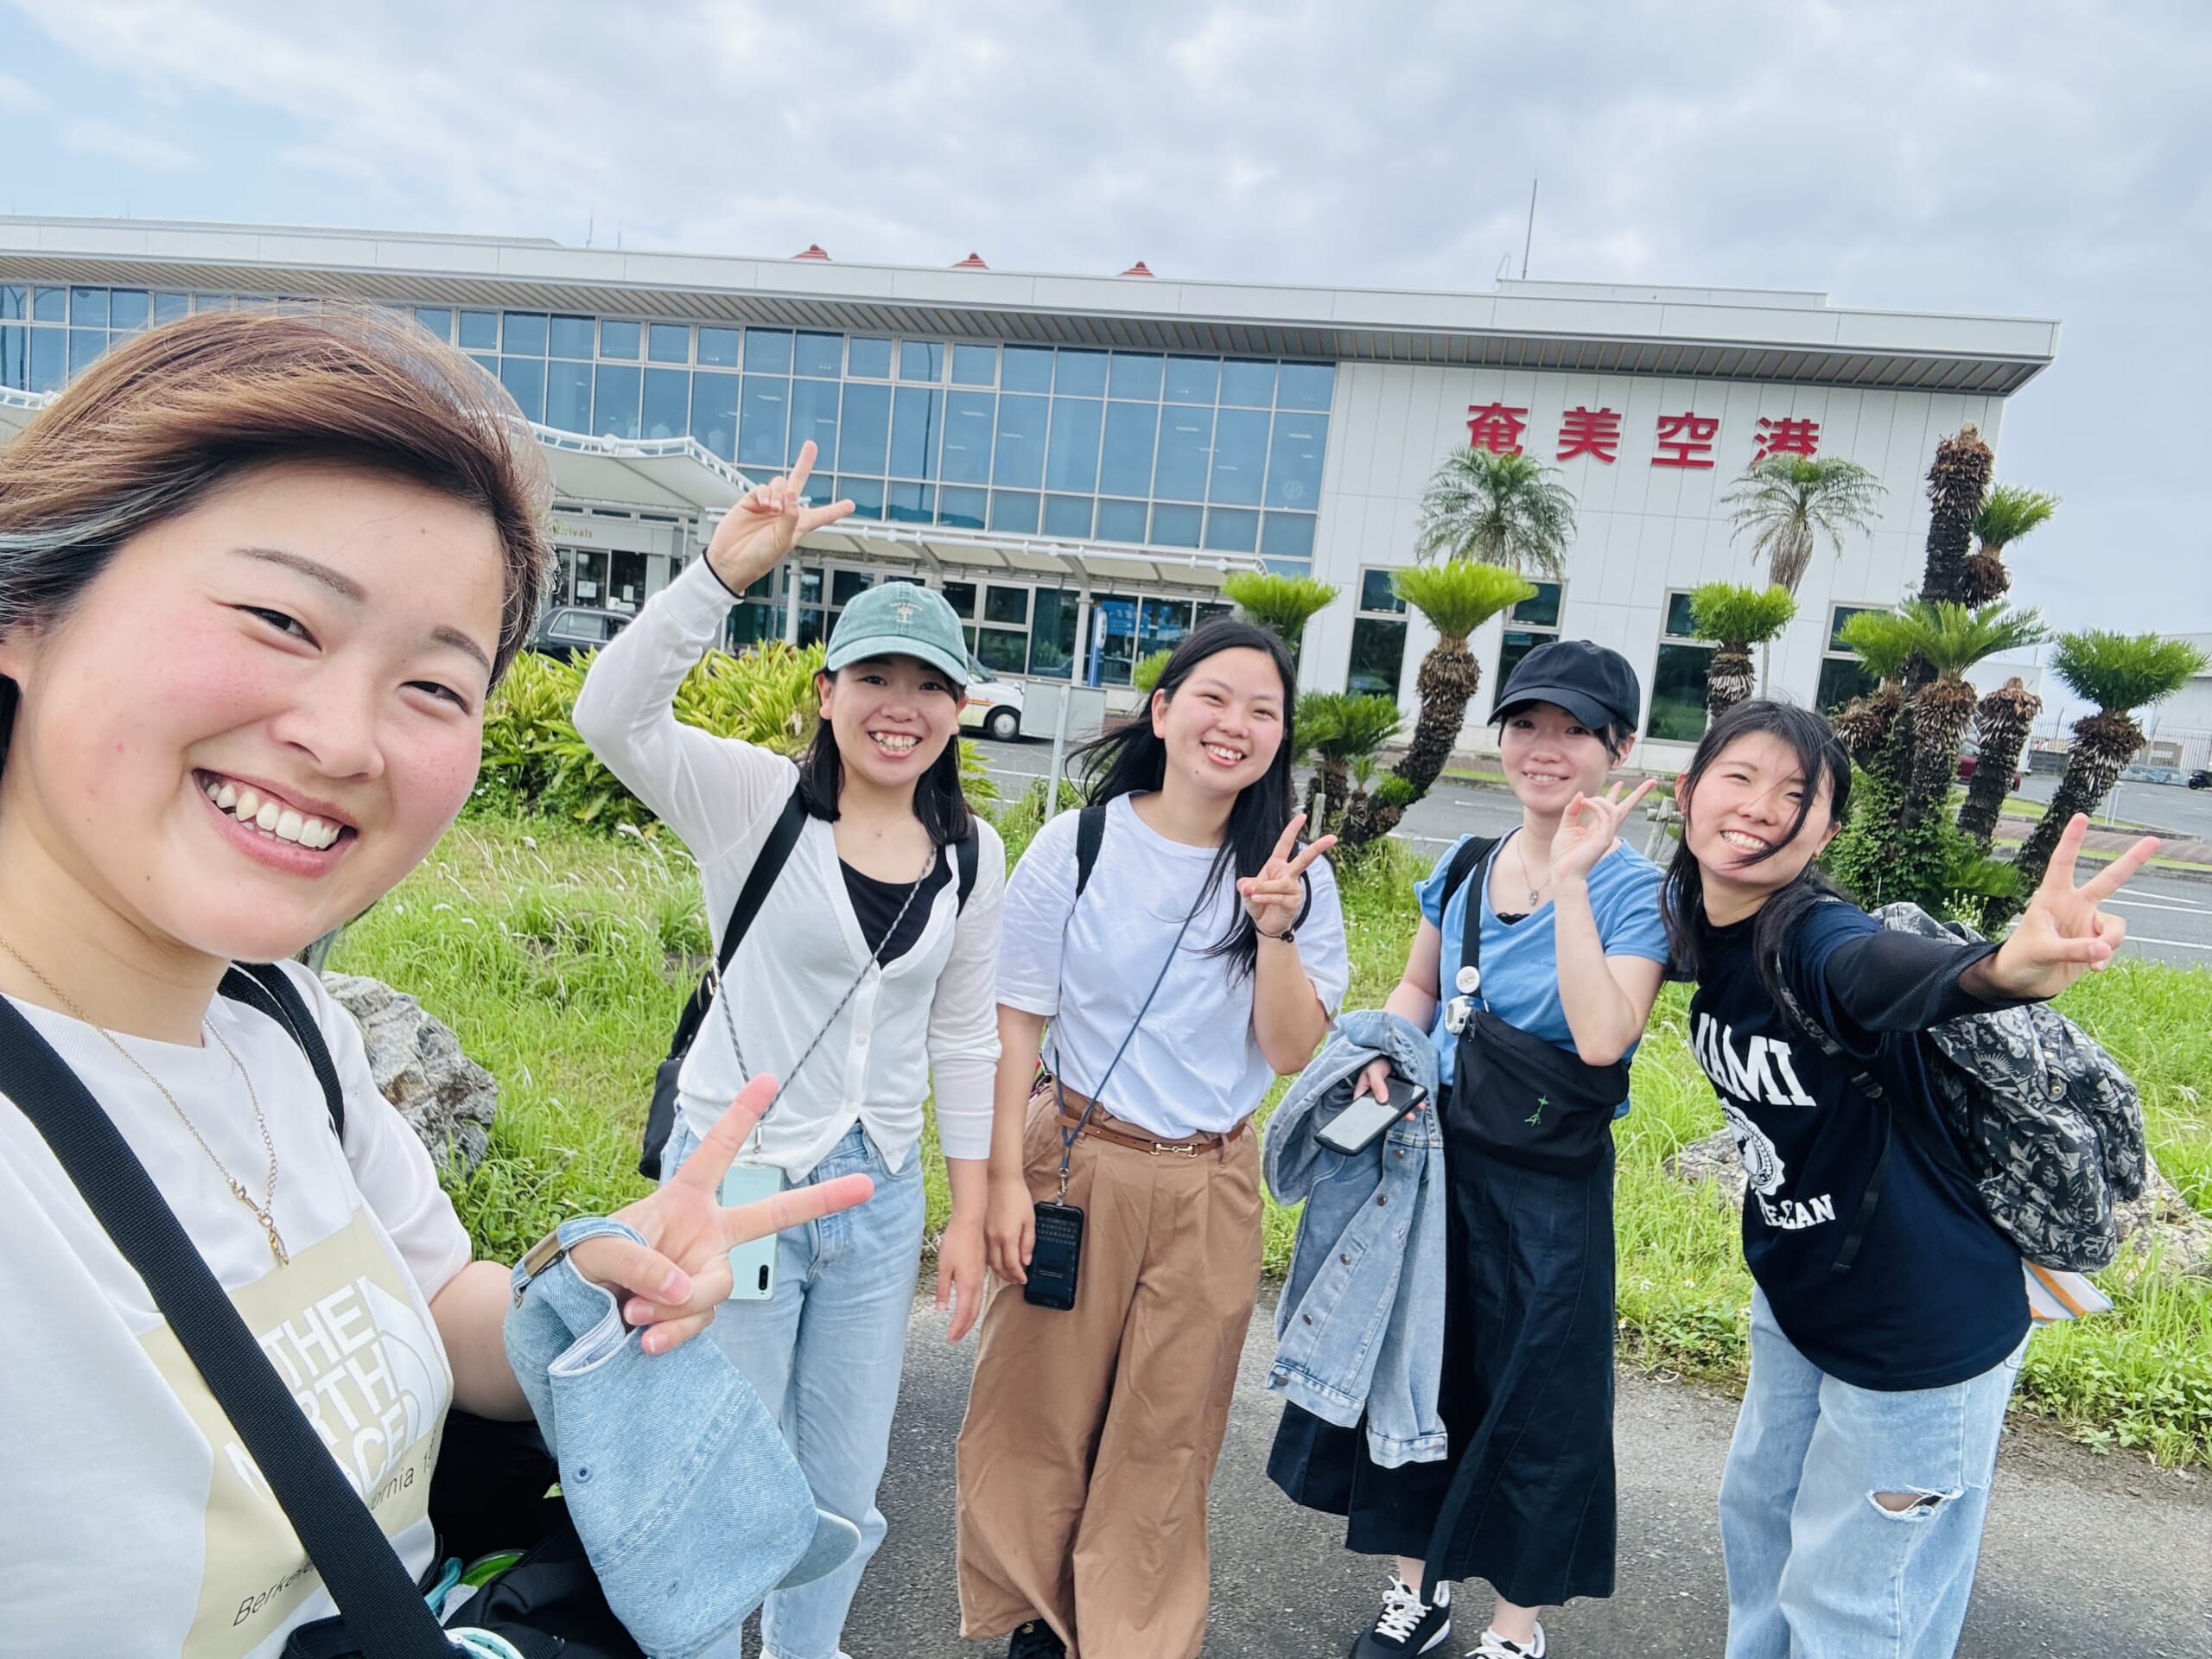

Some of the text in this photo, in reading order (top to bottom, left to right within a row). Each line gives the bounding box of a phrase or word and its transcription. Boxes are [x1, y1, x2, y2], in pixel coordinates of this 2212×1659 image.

[1466, 402, 1820, 469] 奄美空港
[257, 1284, 376, 1390] THE
[223, 1341, 398, 1503] NRTH
[334, 1401, 404, 1499] CE
